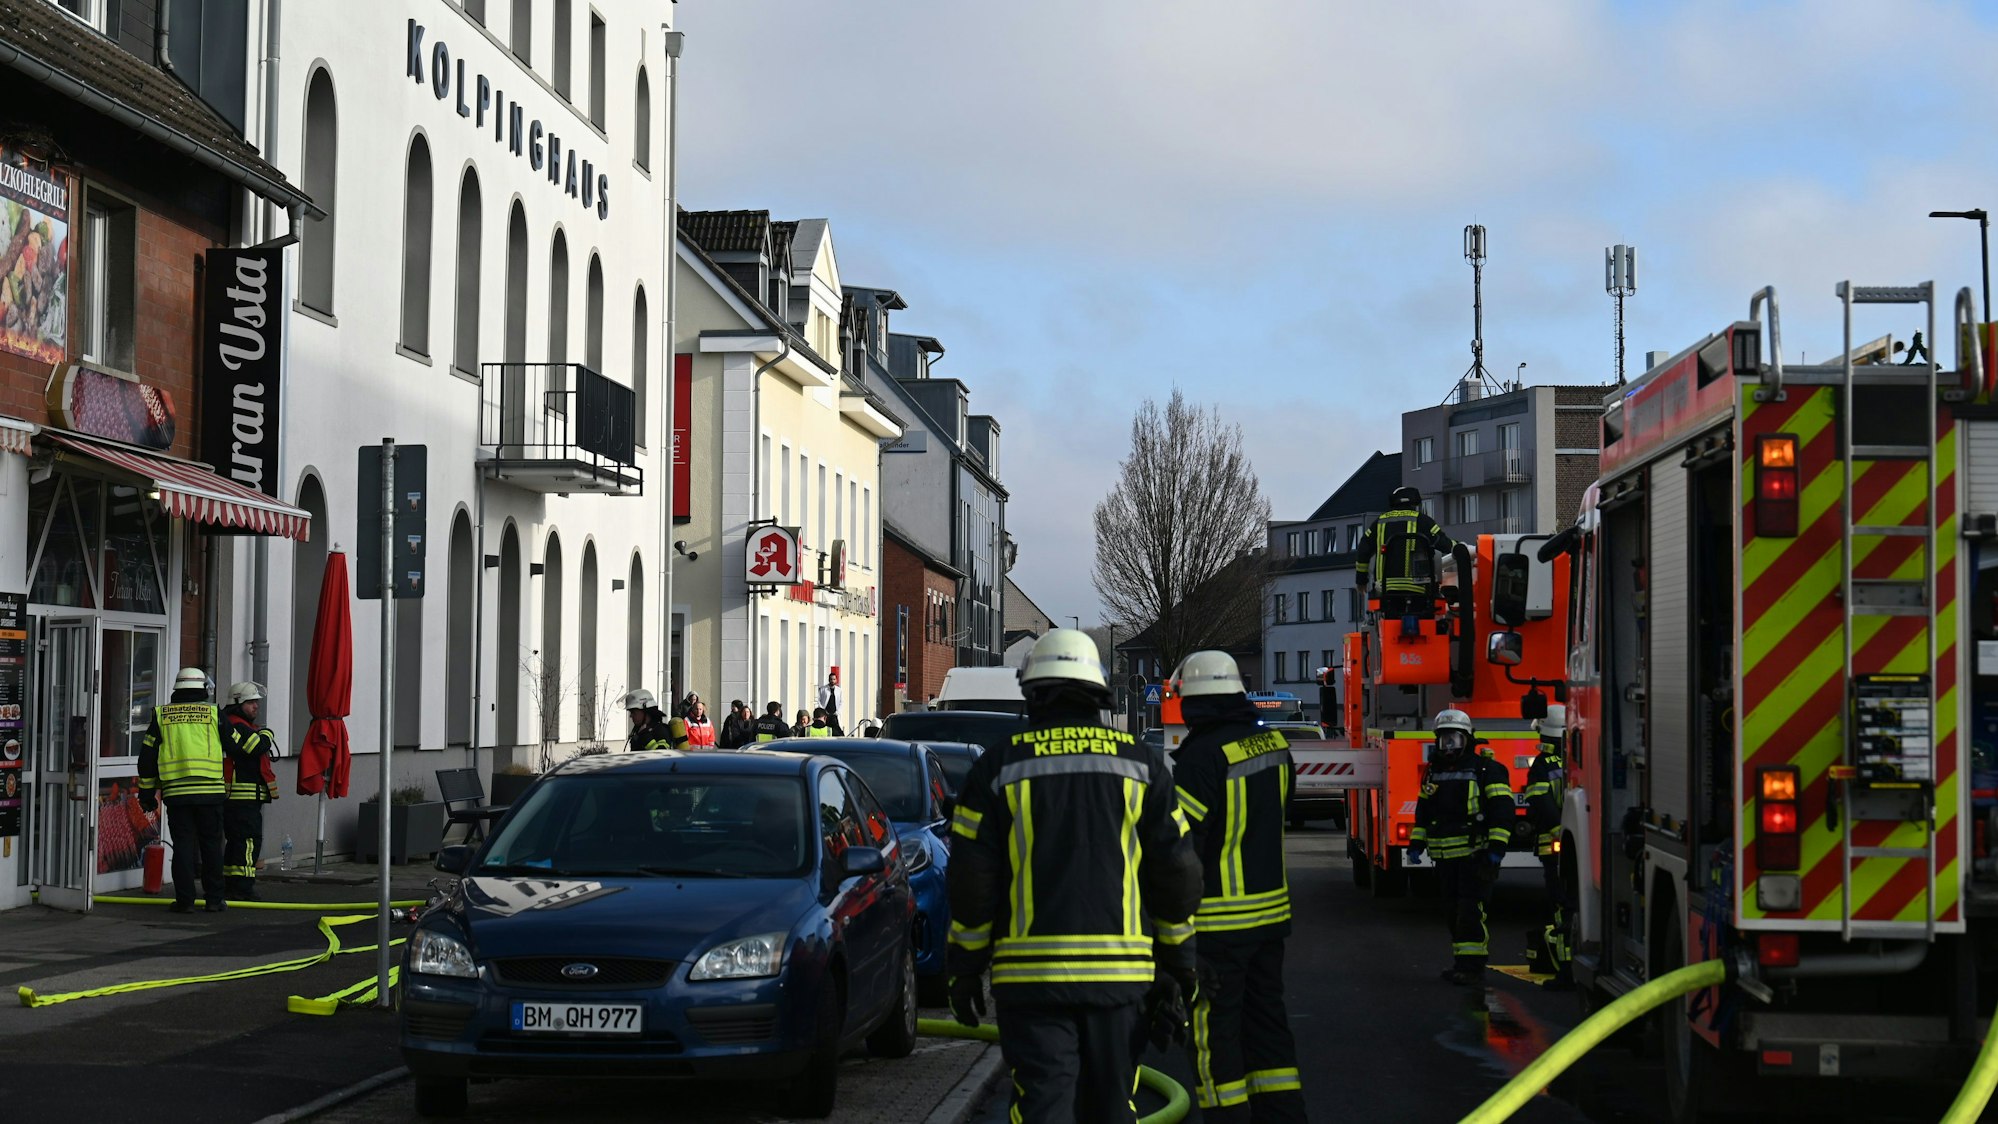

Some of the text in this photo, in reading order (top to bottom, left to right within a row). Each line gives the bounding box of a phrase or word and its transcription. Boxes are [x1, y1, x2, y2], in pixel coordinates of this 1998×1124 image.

[406, 18, 609, 221] KOLPINGHAUS
[218, 256, 268, 493] uran Usta
[1011, 726, 1135, 746] FEUERWEHR
[1033, 739, 1118, 757] KERPEN
[524, 1006, 638, 1029] BM QH 977
